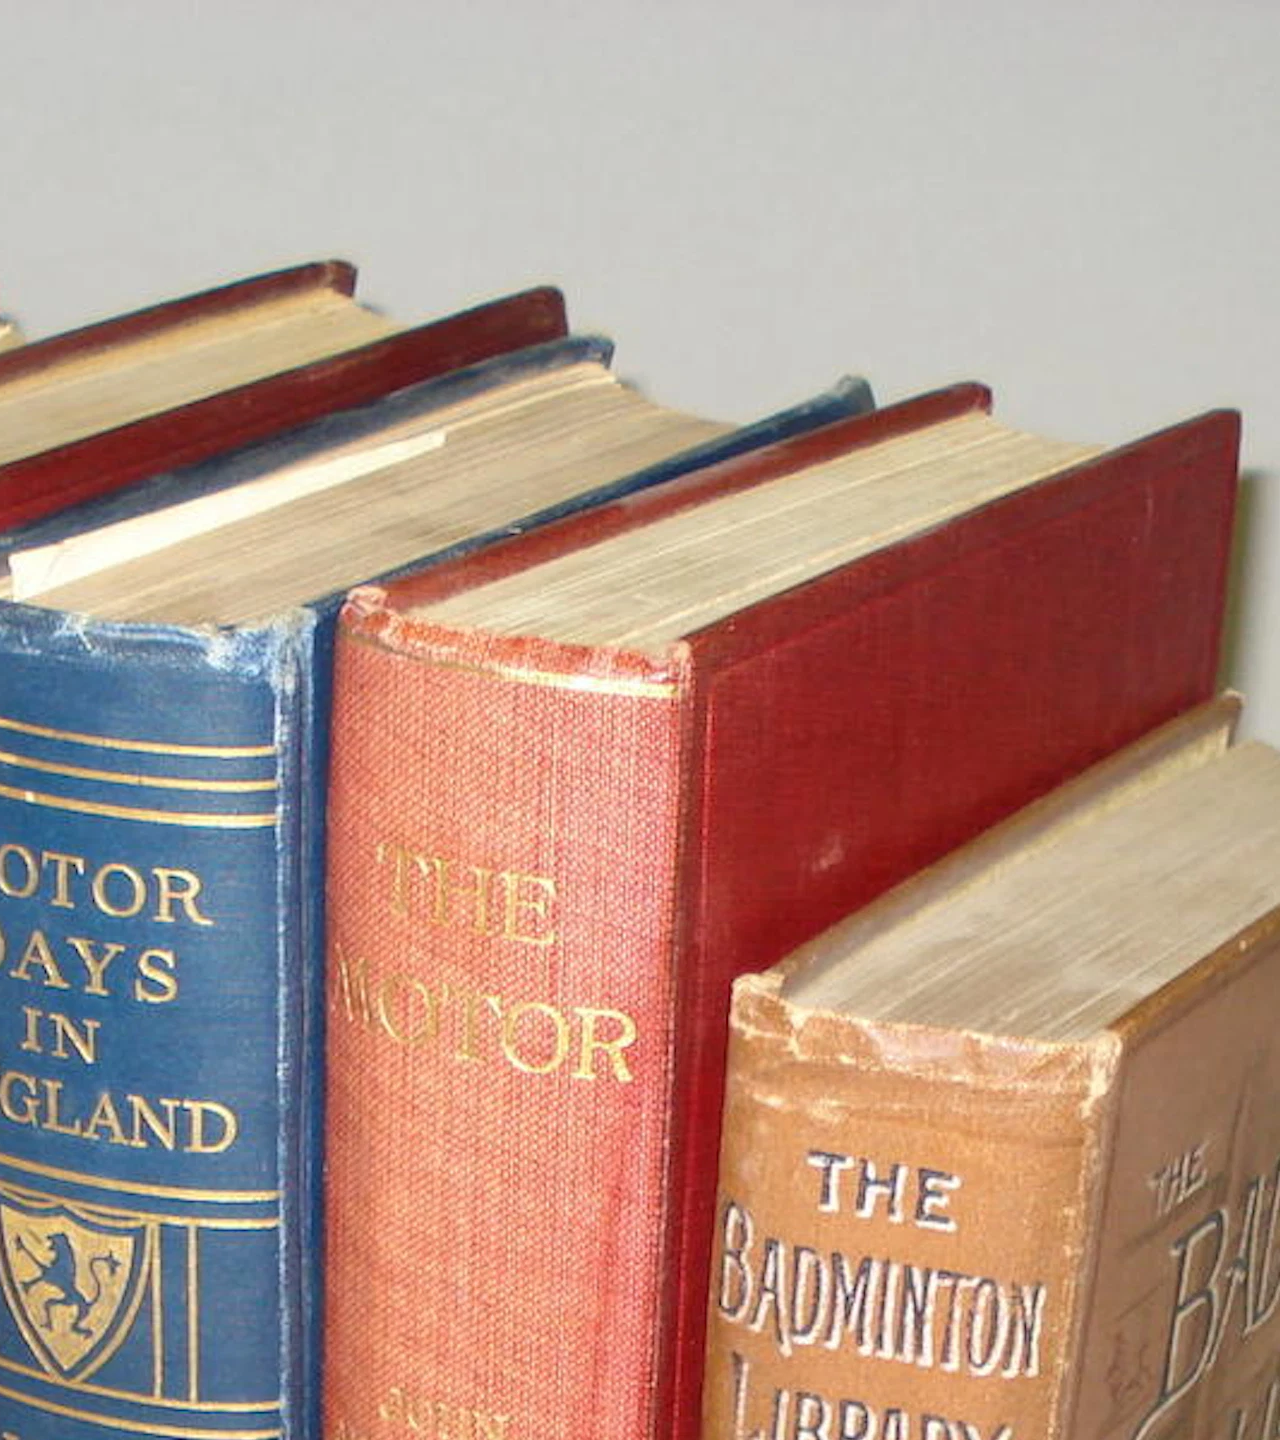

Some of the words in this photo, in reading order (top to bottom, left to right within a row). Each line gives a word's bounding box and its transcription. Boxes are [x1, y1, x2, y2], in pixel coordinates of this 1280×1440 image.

[376, 843, 558, 945] THE
[20, 1005, 101, 1065] IN
[334, 942, 639, 1083] MOTOR
[806, 1150, 964, 1233] THE
[1144, 1141, 1212, 1217] THE
[719, 1199, 1046, 1379] BADMINTON
